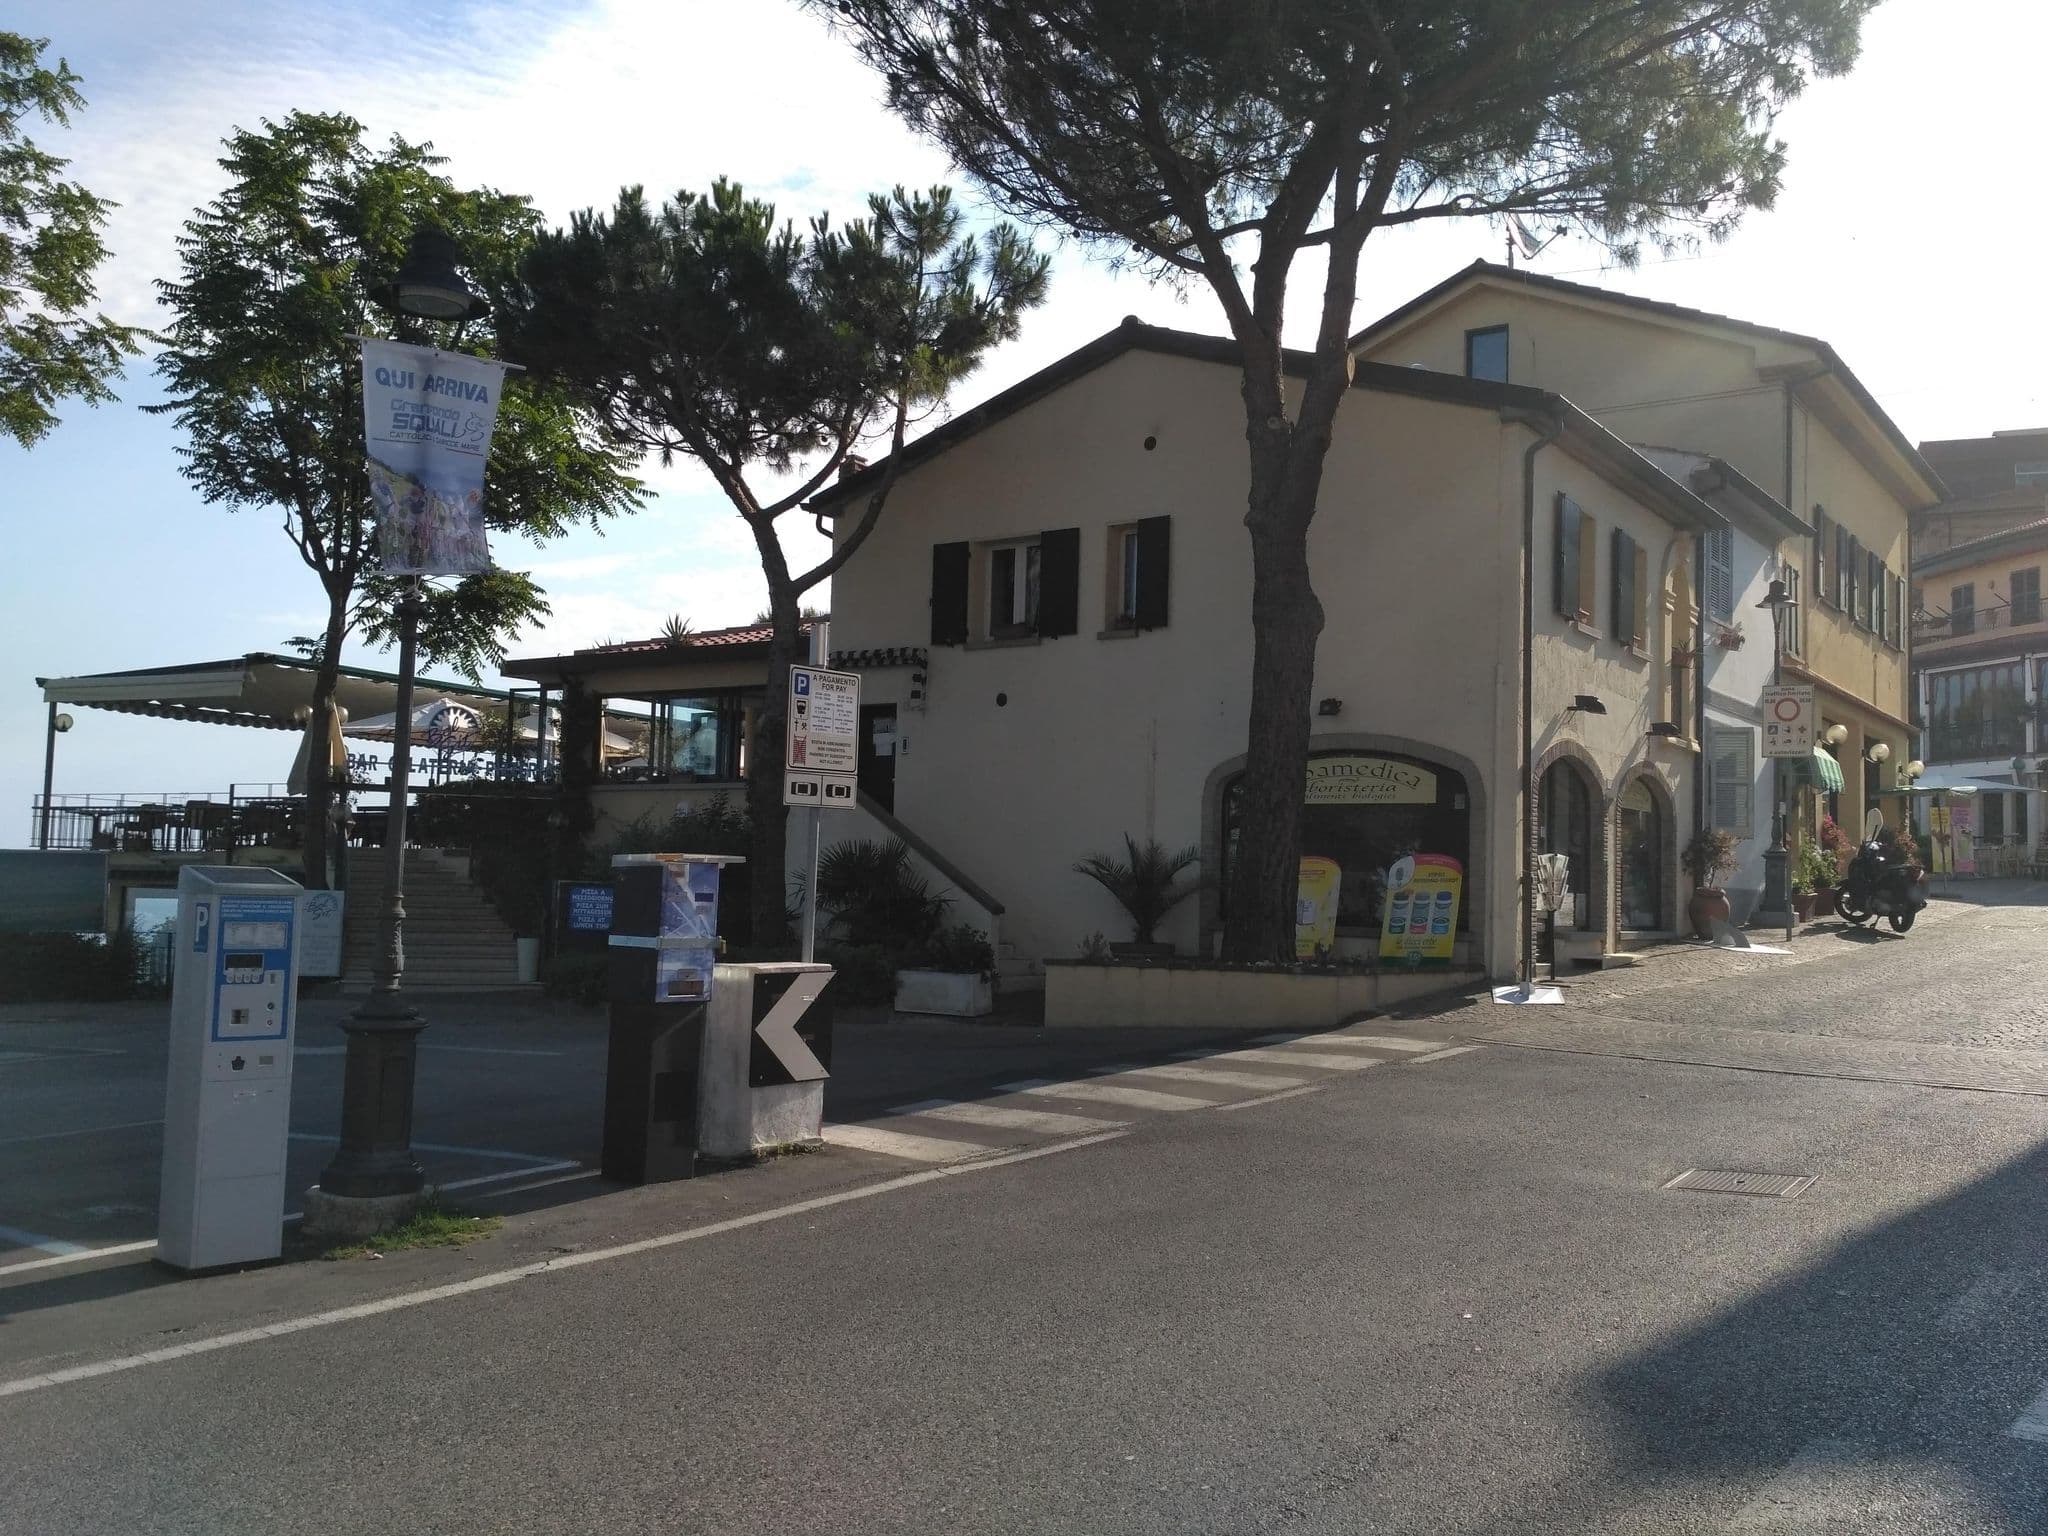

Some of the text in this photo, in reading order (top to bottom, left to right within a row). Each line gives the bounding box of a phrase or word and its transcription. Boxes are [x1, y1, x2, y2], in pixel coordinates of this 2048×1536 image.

[375, 367, 489, 404] QUI ARRIVA
[798, 676, 808, 692] P
[813, 673, 857, 687] A PAGAMENTO
[821, 682, 848, 694] FOR PAY
[347, 753, 378, 771] BAR
[194, 905, 209, 943] P
